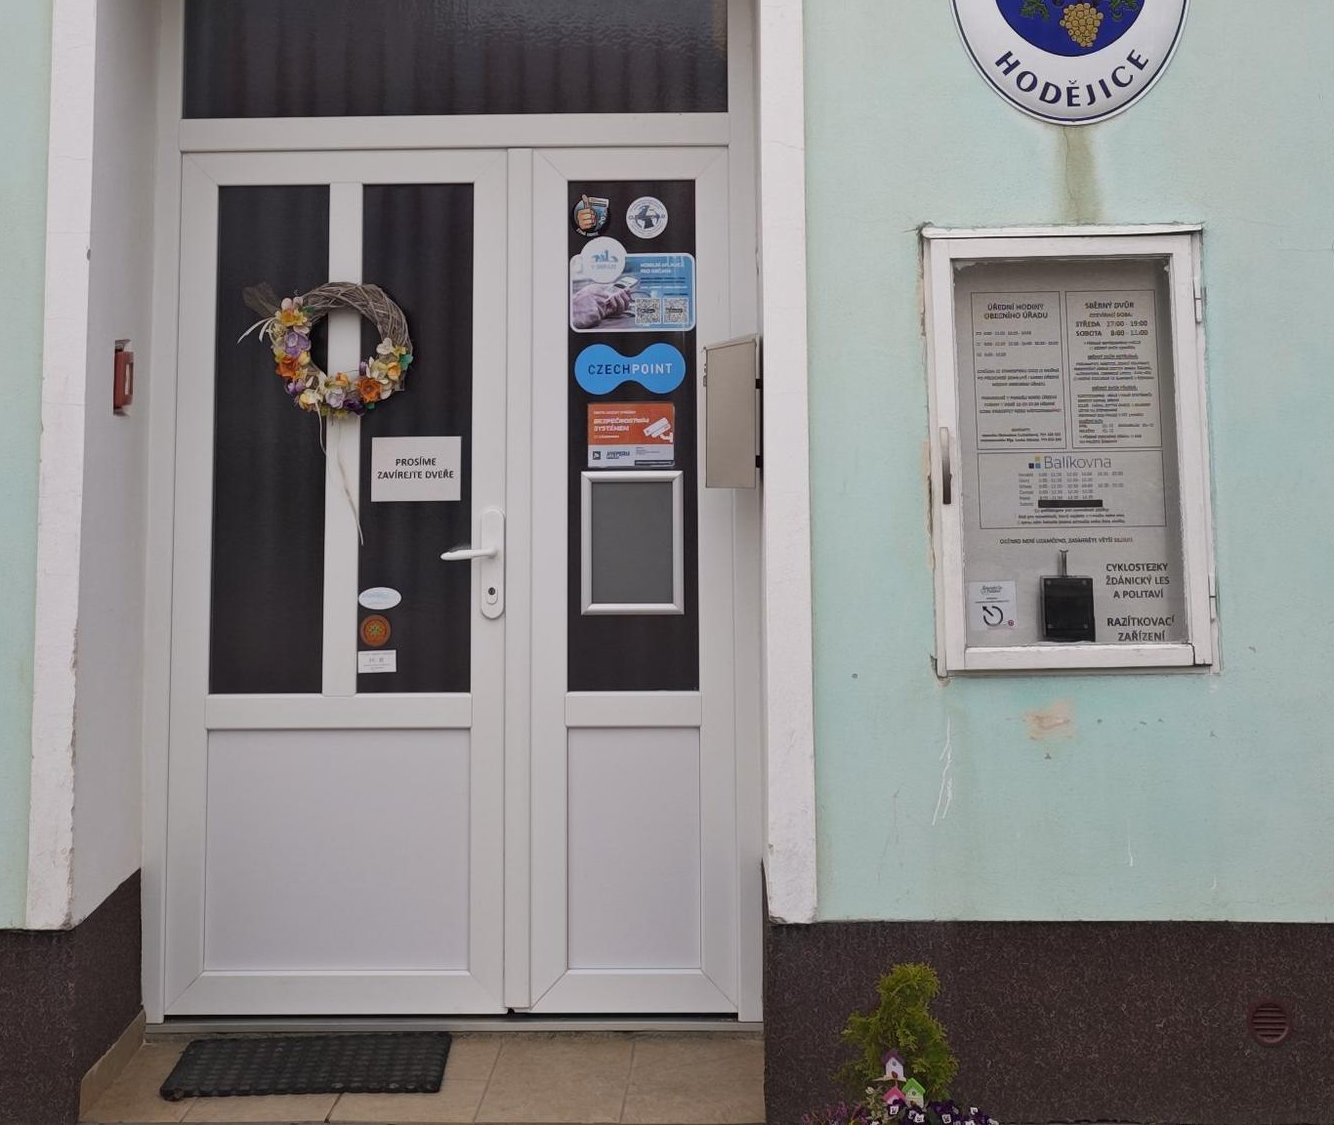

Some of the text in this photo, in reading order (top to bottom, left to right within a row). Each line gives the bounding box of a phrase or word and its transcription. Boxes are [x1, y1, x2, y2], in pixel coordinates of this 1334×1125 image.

[994, 48, 1150, 107] HODĚJICE
[1114, 300, 1134, 309] DVŮR
[1022, 310, 1049, 319] ÚŘADU
[1075, 320, 1101, 328] STŘEDA
[395, 456, 436, 467] PROSÍME
[1043, 455, 1112, 469] Balíkovna
[377, 468, 454, 480] ZAVÍREJTE DVEŘE
[1106, 562, 1168, 572] CYKLOSTEZKY
[1106, 575, 1170, 585] ŽDÁNICKÝ LES
[1113, 588, 1164, 598] A POLITAVÍ
[1118, 630, 1165, 642] ZAŘÍZENÍ
